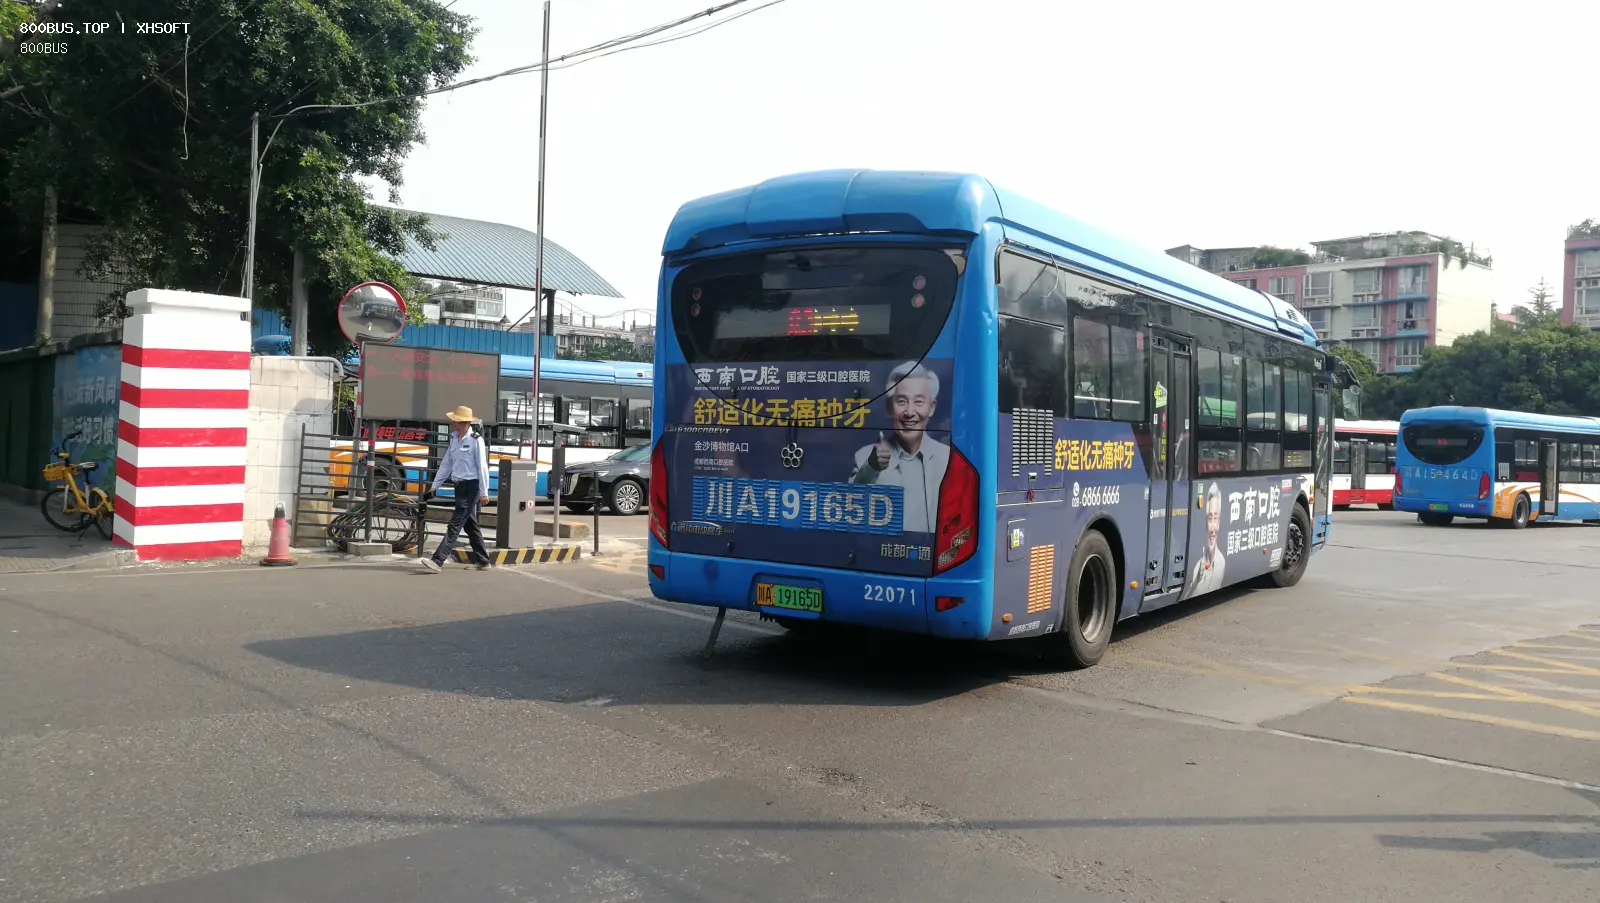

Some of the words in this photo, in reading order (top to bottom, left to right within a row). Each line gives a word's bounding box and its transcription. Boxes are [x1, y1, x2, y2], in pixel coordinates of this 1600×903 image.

[694, 365, 780, 386] 西南口腔
[786, 370, 870, 383] 国家三级口腔医院
[694, 396, 872, 428] 舒适化无痛种牙
[694, 440, 749, 453] 金沙博物馆A口
[1054, 438, 1134, 471] 舒适化无痛种牙
[706, 480, 893, 527] 川A19165D
[1102, 485, 1120, 505] 6666
[1229, 485, 1281, 525] 西南口腔
[880, 543, 931, 561] 成都广通
[1227, 522, 1279, 556] 国家三级口腔医院
[864, 584, 915, 606] 22071
